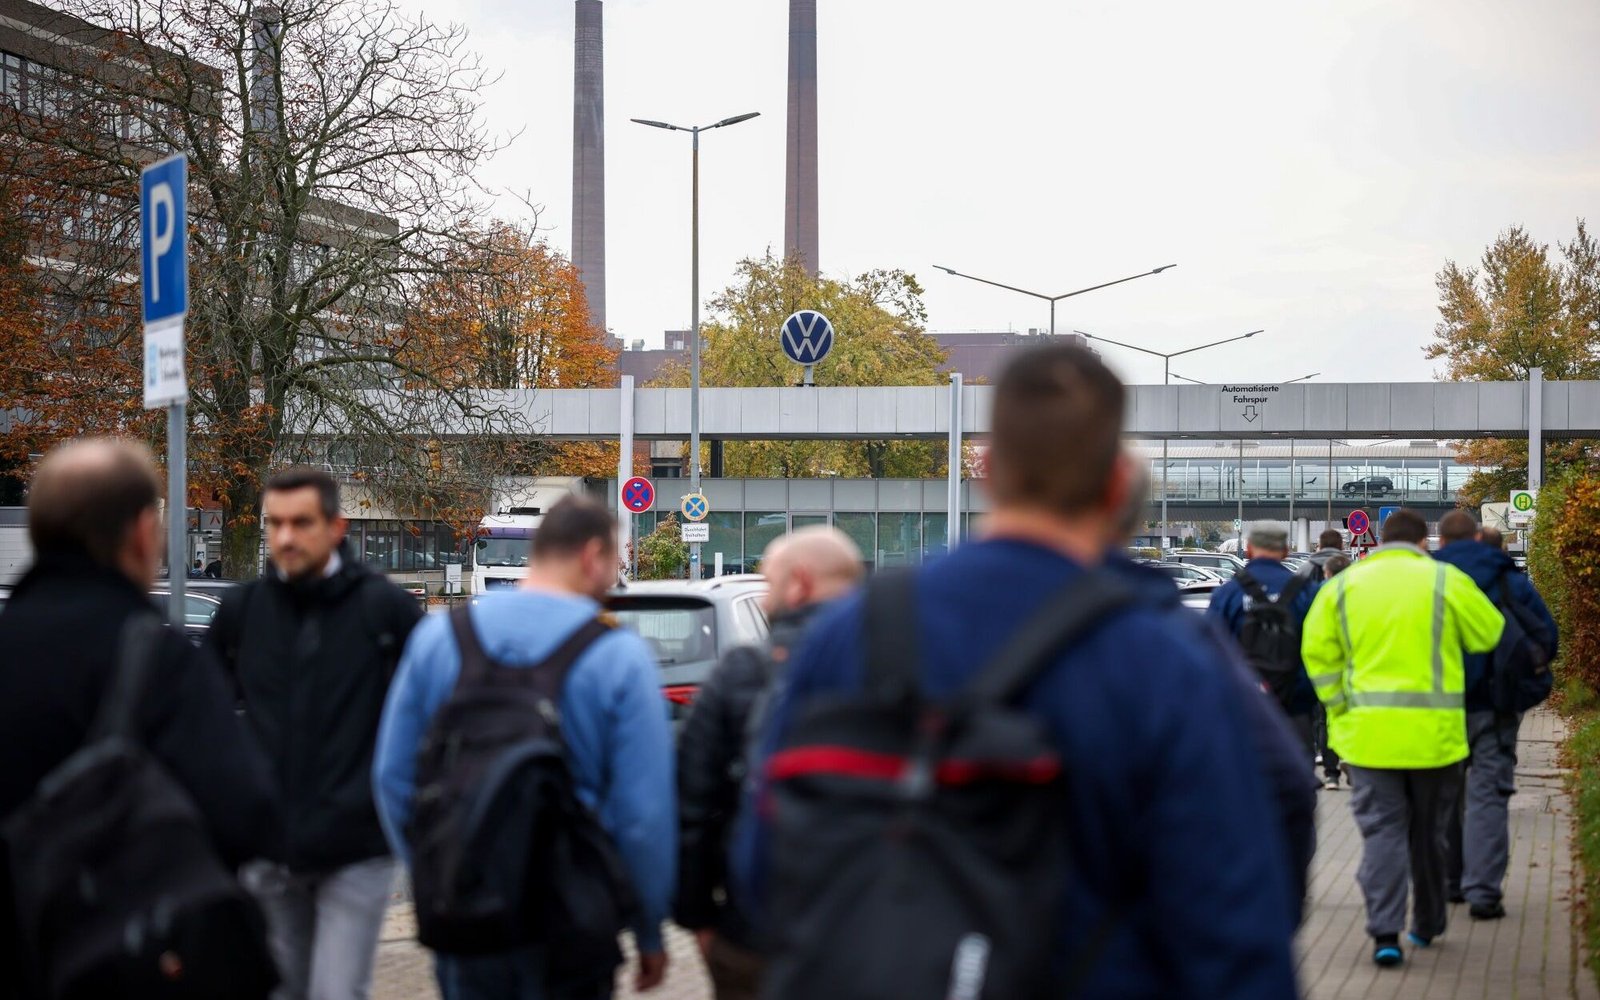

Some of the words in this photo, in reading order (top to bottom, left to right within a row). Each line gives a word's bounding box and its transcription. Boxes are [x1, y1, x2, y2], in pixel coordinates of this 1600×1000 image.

[151, 182, 175, 303] P
[783, 312, 832, 361] VW
[1233, 395, 1268, 404] Fahrspur
[1519, 496, 1528, 508] H
